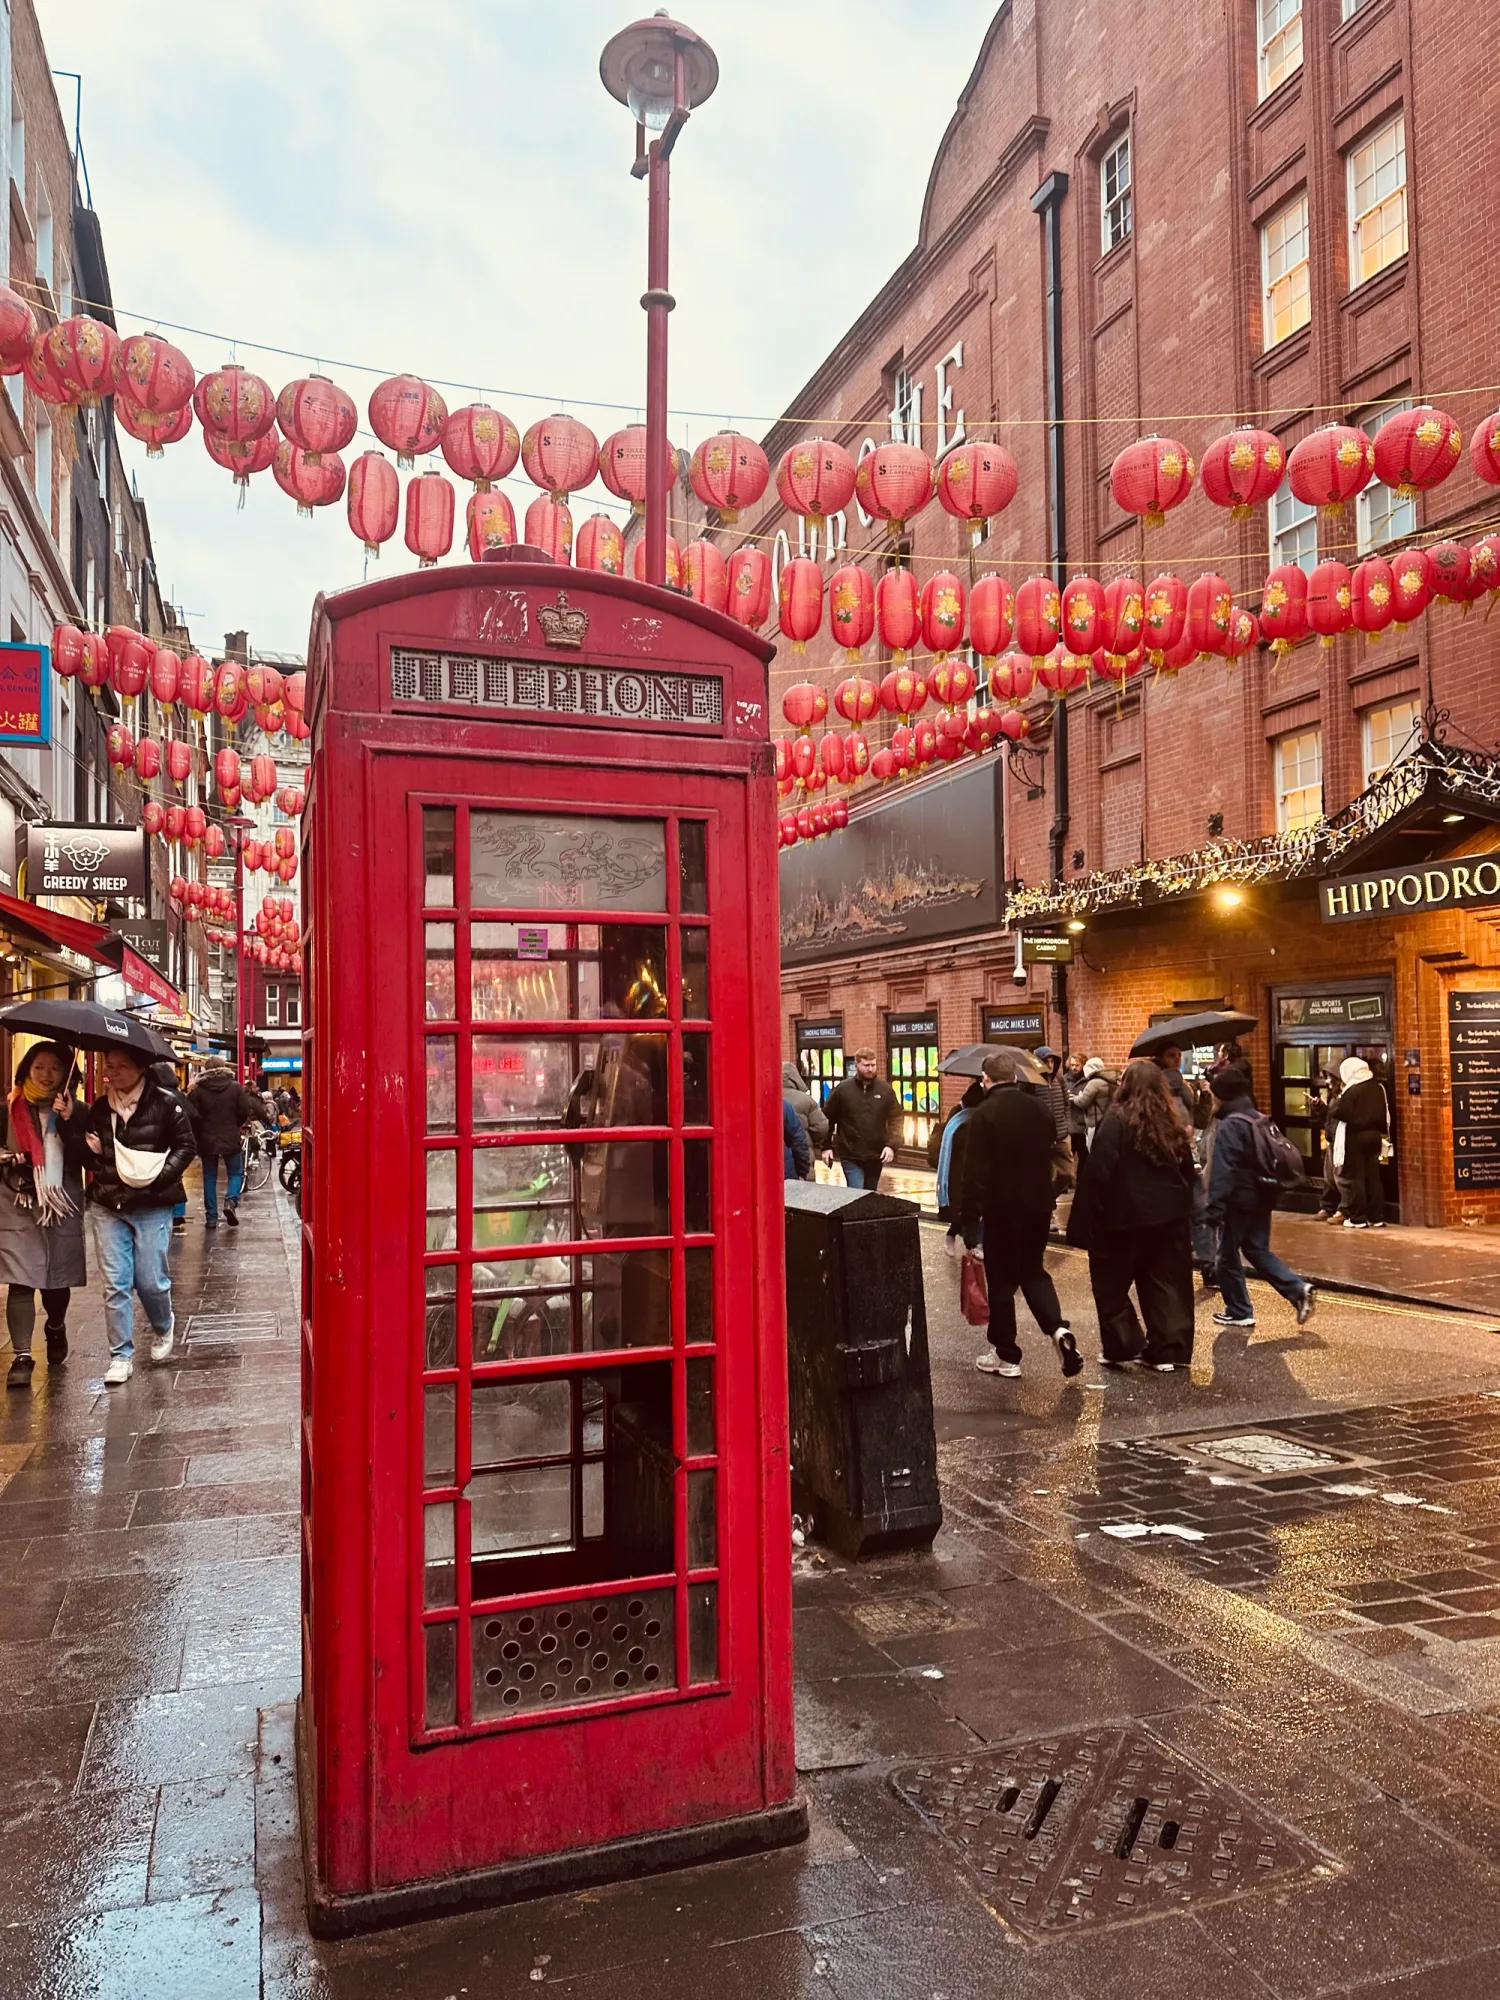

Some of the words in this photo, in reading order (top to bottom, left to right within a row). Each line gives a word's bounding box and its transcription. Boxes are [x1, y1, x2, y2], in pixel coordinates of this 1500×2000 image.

[407, 656, 710, 718] TELEPHONE
[43, 875, 89, 890] GREEDY
[92, 877, 128, 891] SHEEP
[1327, 862, 1500, 916] HIPPODRO
[141, 939, 160, 947] CUT
[1034, 937, 1070, 945] HIPPODROME
[1309, 1007, 1330, 1015] SHOWN
[1330, 1006, 1344, 1014] HERE
[1455, 1001, 1462, 1011] 5
[911, 1023, 924, 1031] OPEN
[991, 1020, 1009, 1029] MAGIC
[1010, 1019, 1025, 1029] MIKE
[1026, 1018, 1040, 1028] LIVE
[1456, 1033, 1463, 1043] 4
[1457, 1063, 1464, 1073] 3
[1459, 1100, 1464, 1110] 1
[1459, 1136, 1467, 1146] G
[1457, 1168, 1469, 1178] LG
